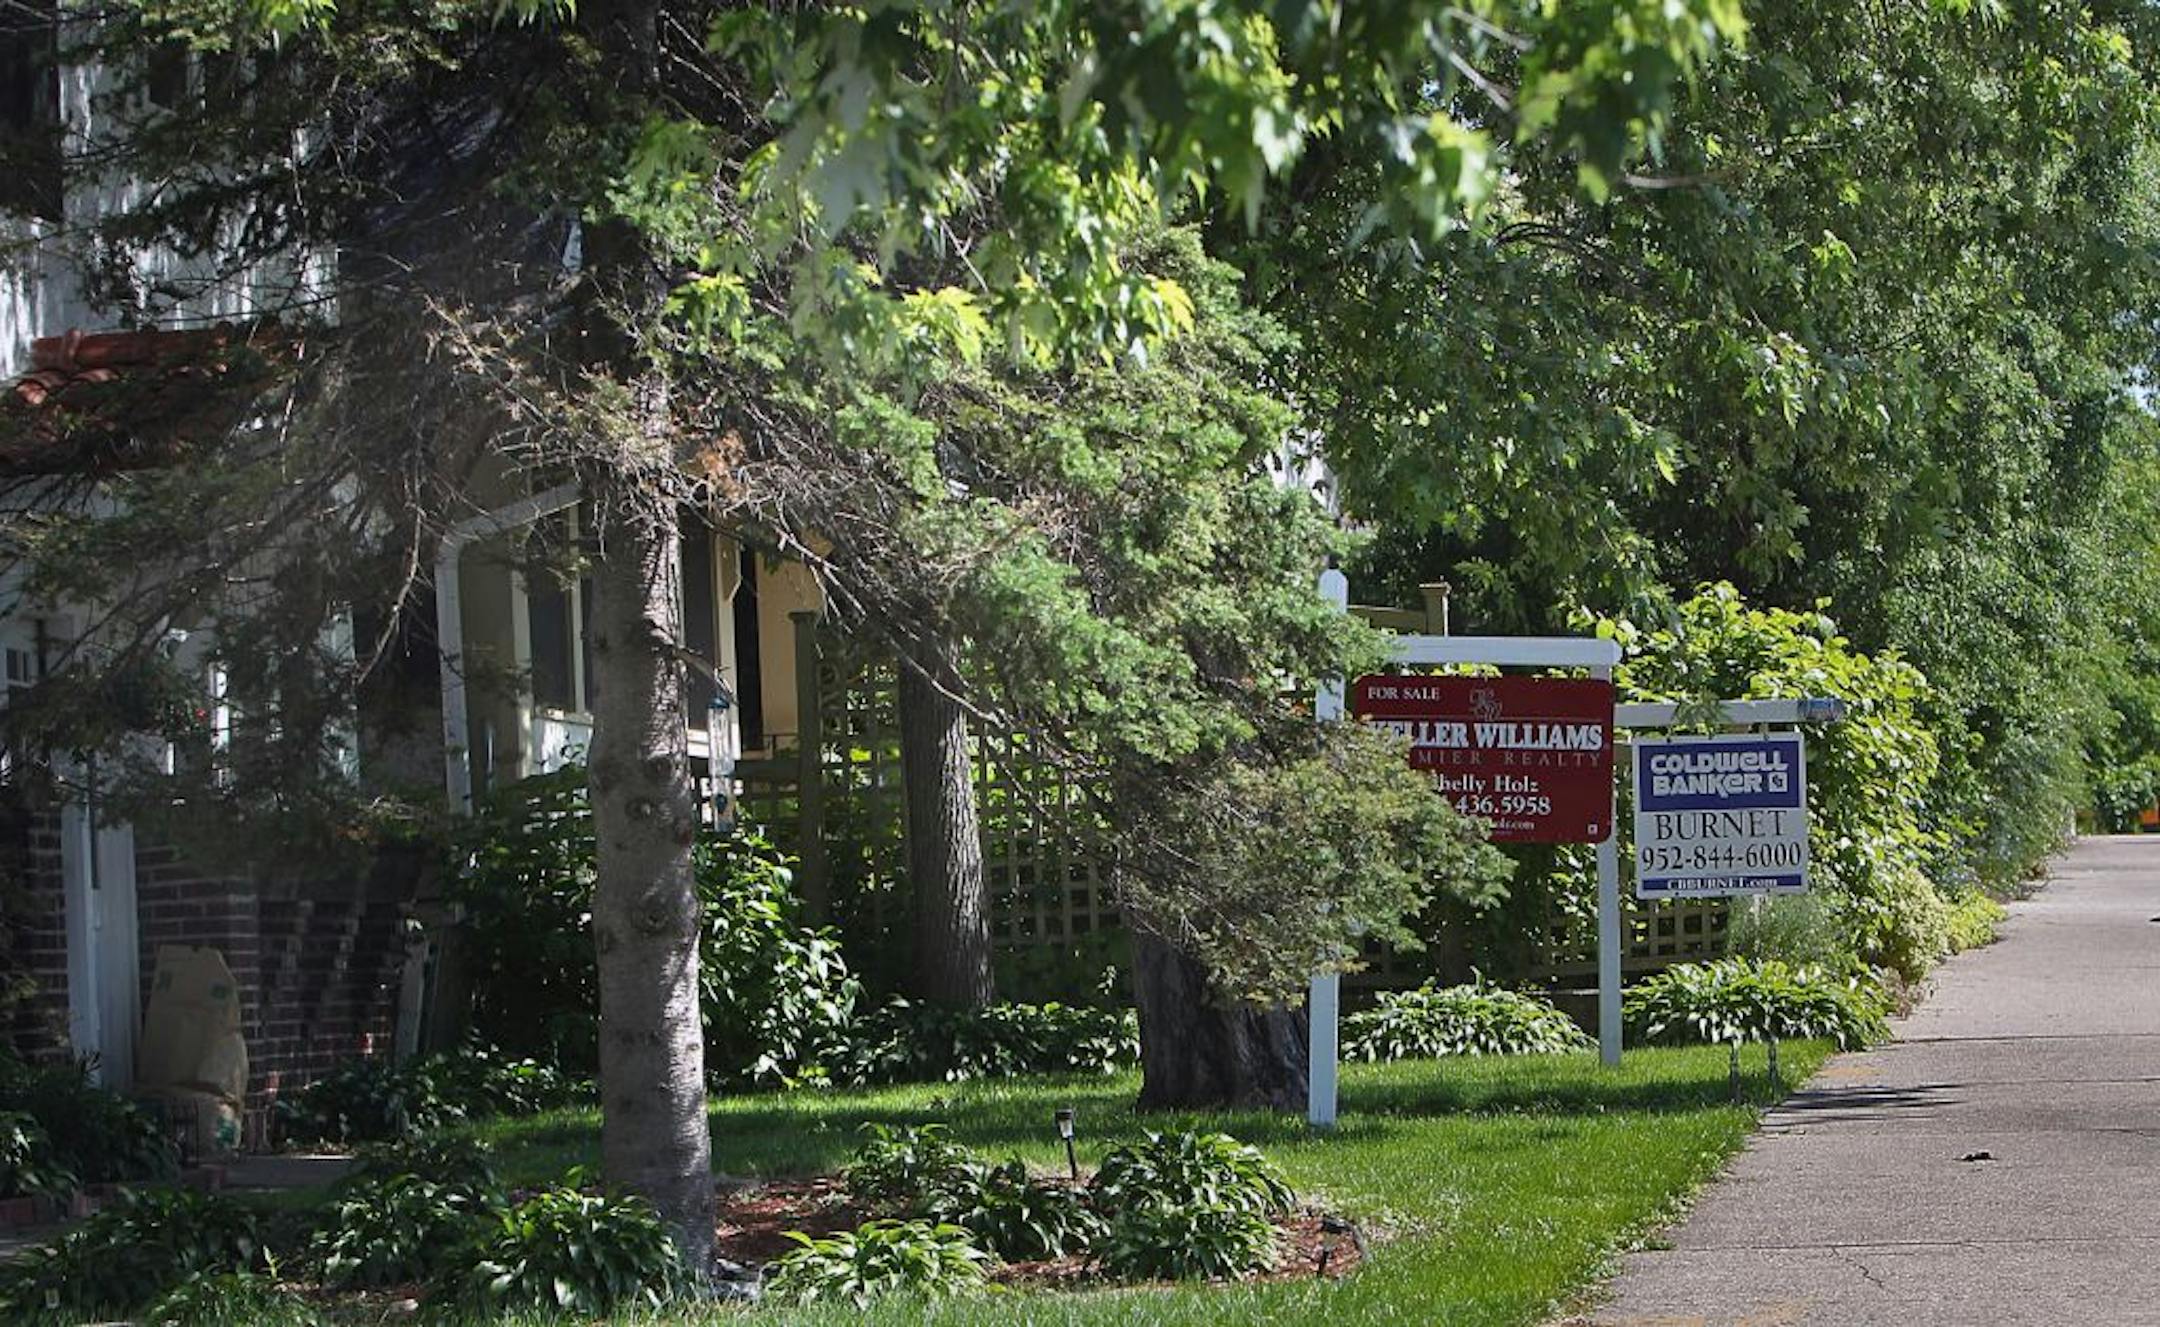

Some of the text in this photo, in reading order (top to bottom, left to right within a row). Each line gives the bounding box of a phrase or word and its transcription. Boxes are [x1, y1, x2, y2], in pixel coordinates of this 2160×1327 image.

[1367, 687, 1440, 700] FOR SALE
[1473, 722, 1602, 750] WILLIAMS
[1504, 752, 1600, 767] REALTY
[1651, 751, 1789, 774] COLDWELL
[1494, 775, 1539, 793] Holz
[1652, 774, 1762, 798] BANKER
[1655, 811, 1787, 840] BURNET
[1642, 842, 1801, 871] 952-844-6000
